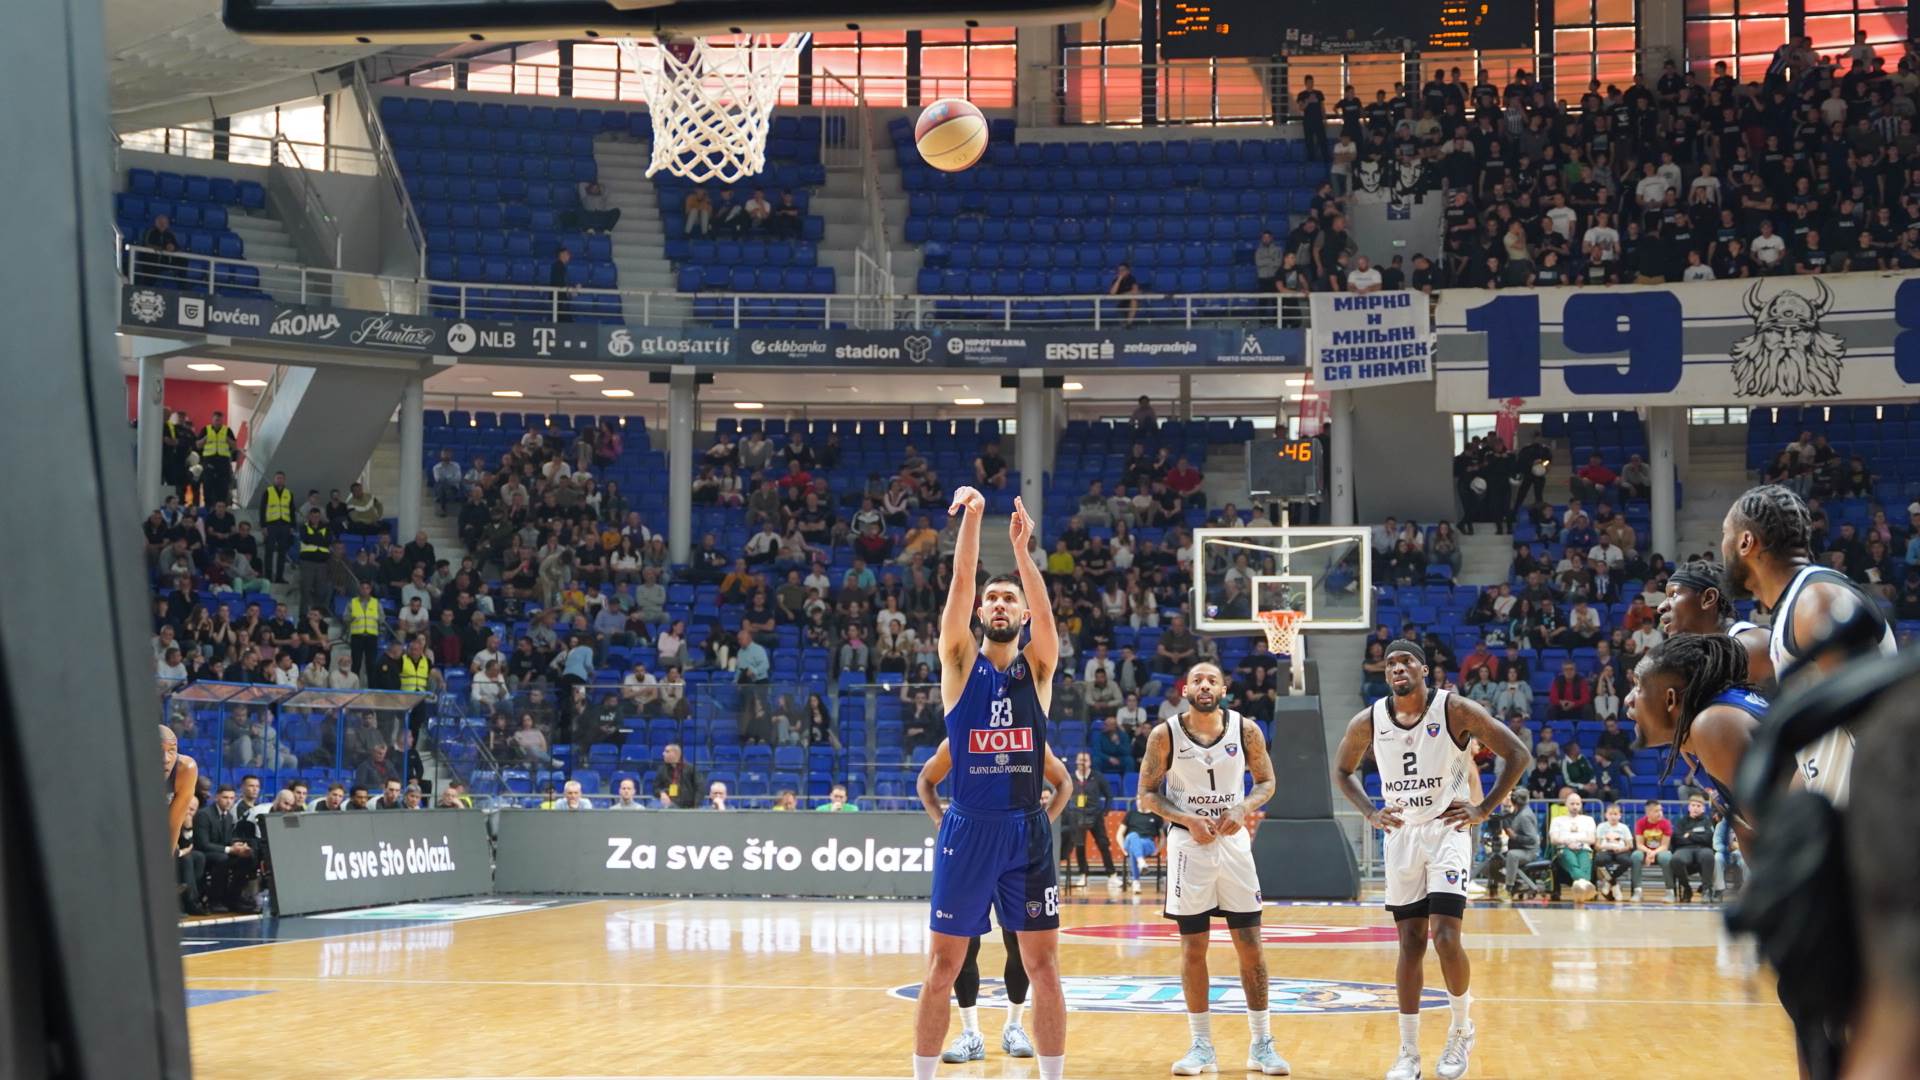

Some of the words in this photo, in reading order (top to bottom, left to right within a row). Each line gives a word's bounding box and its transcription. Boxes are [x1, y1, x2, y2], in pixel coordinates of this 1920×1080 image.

[208, 305, 260, 327] lovćen
[269, 312, 341, 336] AROMA
[350, 316, 436, 348] Plantaže
[480, 331, 516, 349] NLB
[641, 336, 730, 355] glosarij
[835, 344, 900, 359] stadion
[1045, 343, 1099, 360] ERSTE
[1123, 341, 1198, 355] zetagradnja
[989, 697, 1014, 728] 83
[975, 730, 1028, 751] VOLI
[969, 766, 989, 775] GLAVNI
[1402, 752, 1418, 776] 2
[1207, 768, 1216, 791] 1
[1385, 776, 1443, 793] MOZZART
[1188, 793, 1236, 805] MOZZART
[1409, 795, 1433, 808] NIS
[321, 845, 348, 881] Za
[350, 849, 378, 879] sve
[379, 841, 405, 876] što
[406, 835, 455, 874] dolazi.
[606, 837, 656, 869] Za
[666, 844, 733, 870] sve
[742, 838, 802, 871] što
[811, 837, 934, 872] dolazi
